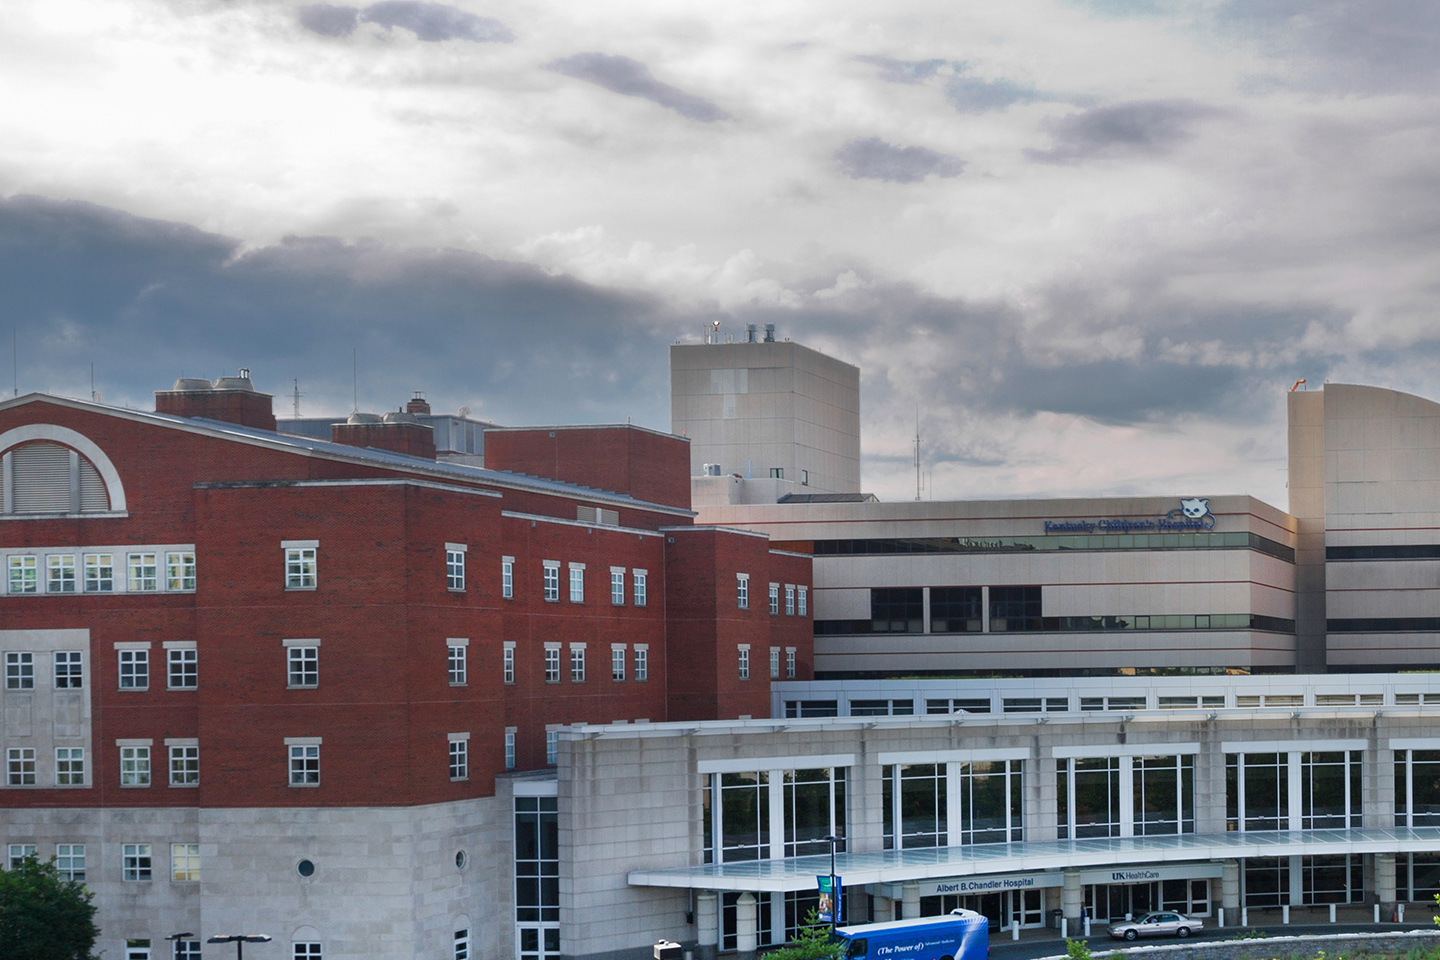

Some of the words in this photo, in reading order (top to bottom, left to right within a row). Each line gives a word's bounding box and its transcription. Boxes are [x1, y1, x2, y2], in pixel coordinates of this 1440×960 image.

[1044, 520, 1095, 533] Kentucky
[1098, 519, 1154, 531] Children's
[1157, 518, 1203, 532] Hospital
[1112, 872, 1125, 880] UK
[1125, 871, 1160, 880] HealthCare
[936, 884, 959, 892] Albert
[961, 882, 968, 891] B.
[968, 880, 1002, 890] Chandler
[1003, 878, 1034, 888] Hospital
[877, 947, 893, 956] (The
[894, 944, 914, 953] Power
[914, 942, 924, 951] of)
